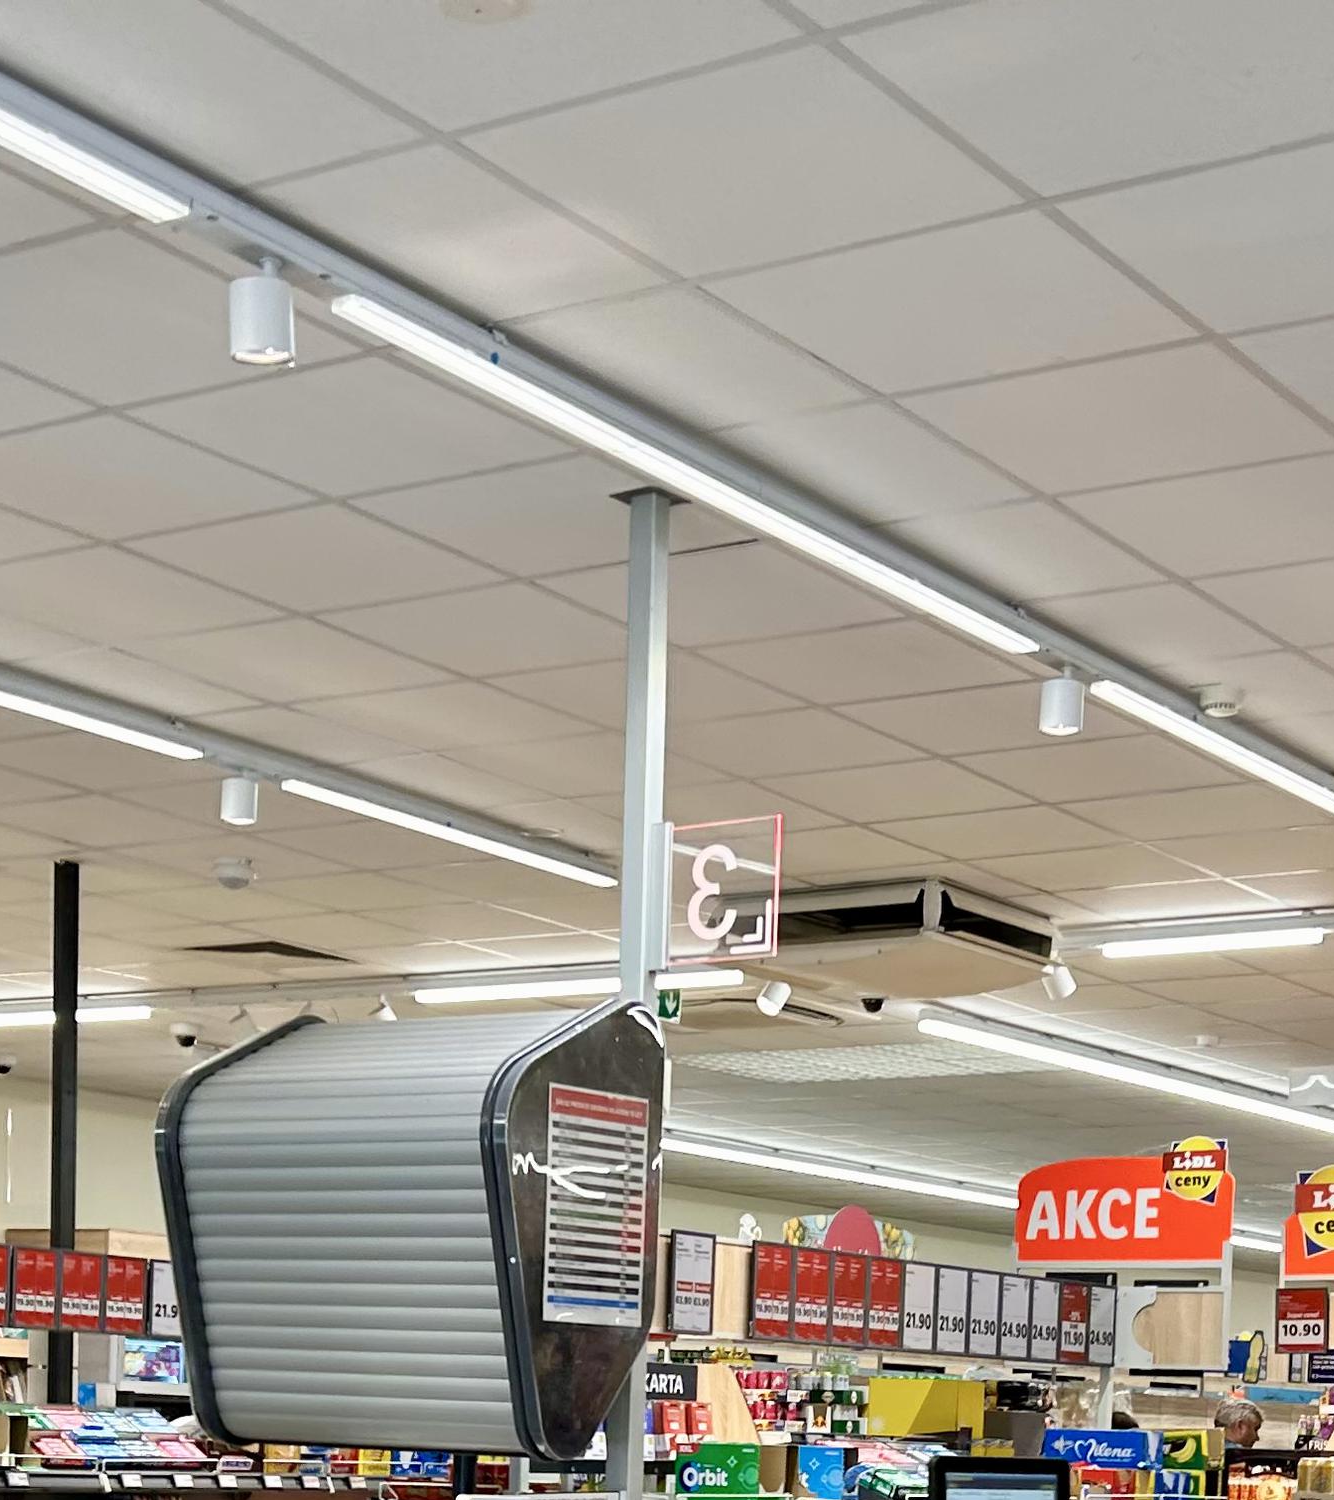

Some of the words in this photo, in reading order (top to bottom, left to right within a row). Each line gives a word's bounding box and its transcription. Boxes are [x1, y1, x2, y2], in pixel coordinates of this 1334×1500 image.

[1175, 1174, 1211, 1188] ceny
[1025, 1187, 1161, 1240] AKCE
[154, 1303, 178, 1319] 21.9
[905, 1312, 931, 1330] 21.90
[939, 1316, 965, 1333] 21.90
[971, 1319, 996, 1337] 21.90
[1002, 1322, 1028, 1339] 24.90
[1032, 1325, 1057, 1341] 24.90
[1063, 1331, 1084, 1346] 11.90
[1090, 1330, 1113, 1346] 24.90
[1281, 1323, 1321, 1337] 10.90
[1074, 1438, 1136, 1463] Milena
[682, 1467, 729, 1489] Orbit
